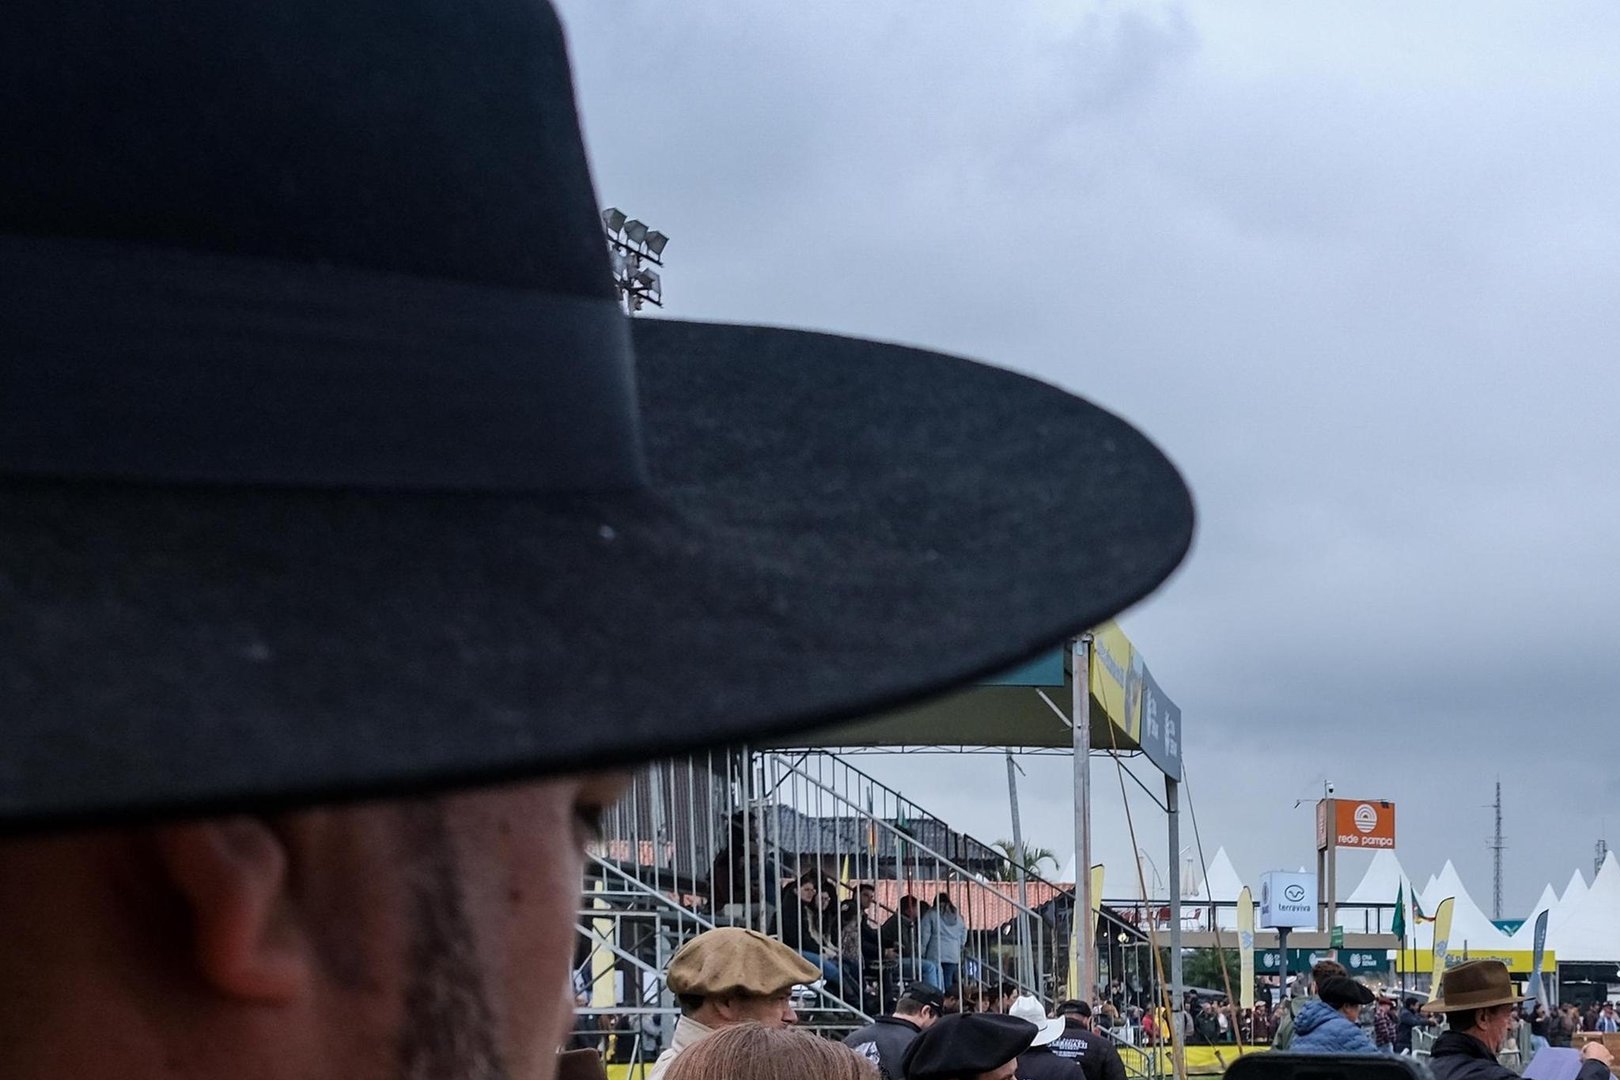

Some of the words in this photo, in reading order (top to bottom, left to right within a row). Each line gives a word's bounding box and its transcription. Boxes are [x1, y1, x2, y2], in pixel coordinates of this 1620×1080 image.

[1338, 835, 1358, 844] rede
[1362, 837, 1393, 846] pampa
[1279, 904, 1310, 912] terraviva
